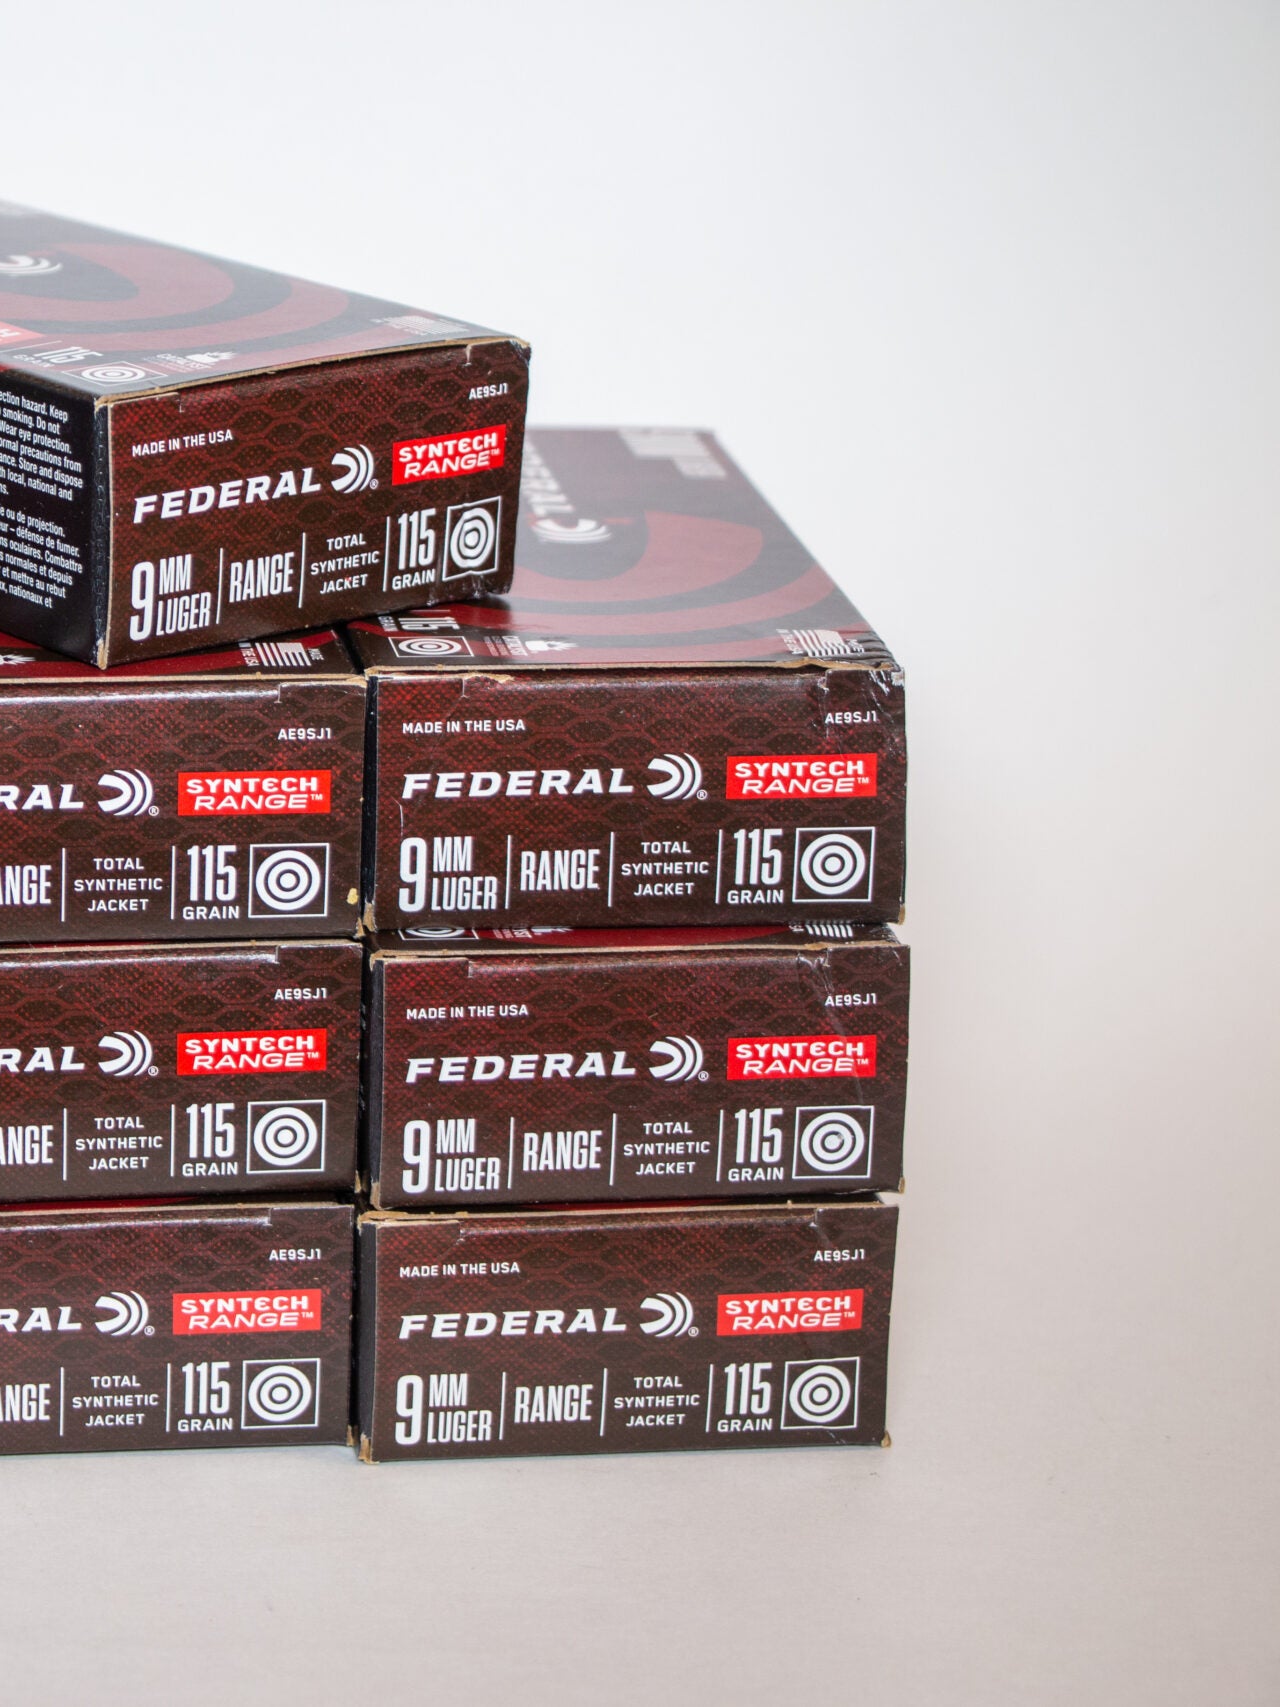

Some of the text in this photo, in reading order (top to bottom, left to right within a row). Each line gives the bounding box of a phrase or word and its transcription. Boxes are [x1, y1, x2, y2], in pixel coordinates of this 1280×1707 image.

[34, 346, 103, 364] 115
[469, 383, 508, 401] AE9SJ1
[49, 404, 68, 422] Keep
[132, 429, 233, 457] MADE IN THE USA
[399, 433, 498, 463] SYNTECH
[19, 444, 61, 466] precautions
[63, 455, 81, 472] from
[18, 456, 37, 473] Store
[53, 469, 83, 488] dispose
[27, 477, 56, 495] national
[133, 467, 321, 524] FEDERAL
[326, 534, 366, 550] TOTAL
[398, 509, 437, 569] 115
[310, 551, 379, 576] SYNTHETIC
[229, 552, 294, 603] RANGE
[320, 574, 367, 595] JACKET
[393, 569, 435, 591] GRAIN
[157, 593, 211, 636] LUGER
[398, 616, 460, 631] 115
[825, 710, 880, 725] AE9SJ1
[277, 727, 332, 741] AE9SJ1
[734, 759, 866, 779] SYNTECH
[186, 776, 319, 795] SYNTECH
[401, 767, 635, 800] FEDERAL
[732, 827, 784, 886] 115
[186, 844, 238, 902] 115
[519, 848, 601, 891] RANGE
[727, 888, 785, 905] GRAIN
[182, 905, 240, 921] GRAIN
[184, 1034, 315, 1055] SYNTECH
[735, 1040, 865, 1060] SYNTECH
[404, 1050, 637, 1084] FEDERAL
[93, 1116, 145, 1131] TOTAL
[185, 1102, 237, 1159] 115
[74, 1135, 164, 1151] SYNTHETIC
[733, 1107, 784, 1164] 115
[521, 1129, 604, 1172] RANGE
[88, 1156, 150, 1171] JACKET
[181, 1161, 239, 1178] GRAIN
[434, 1156, 501, 1194] LUGER
[727, 1166, 785, 1183] GRAIN
[814, 1249, 867, 1264] AE9SJ1
[180, 1294, 310, 1315] SYNTECH
[725, 1295, 853, 1316] SYNTECH
[397, 1306, 627, 1340] FEDERAL
[181, 1360, 231, 1416] 115
[632, 1374, 683, 1389] TOTAL
[722, 1360, 773, 1416] 115
[513, 1383, 595, 1424] RANGE
[613, 1393, 701, 1409] SYNTHETIC
[177, 1417, 233, 1434] GRAIN
[626, 1413, 687, 1428] JACKET
[717, 1417, 773, 1434] GRAIN
